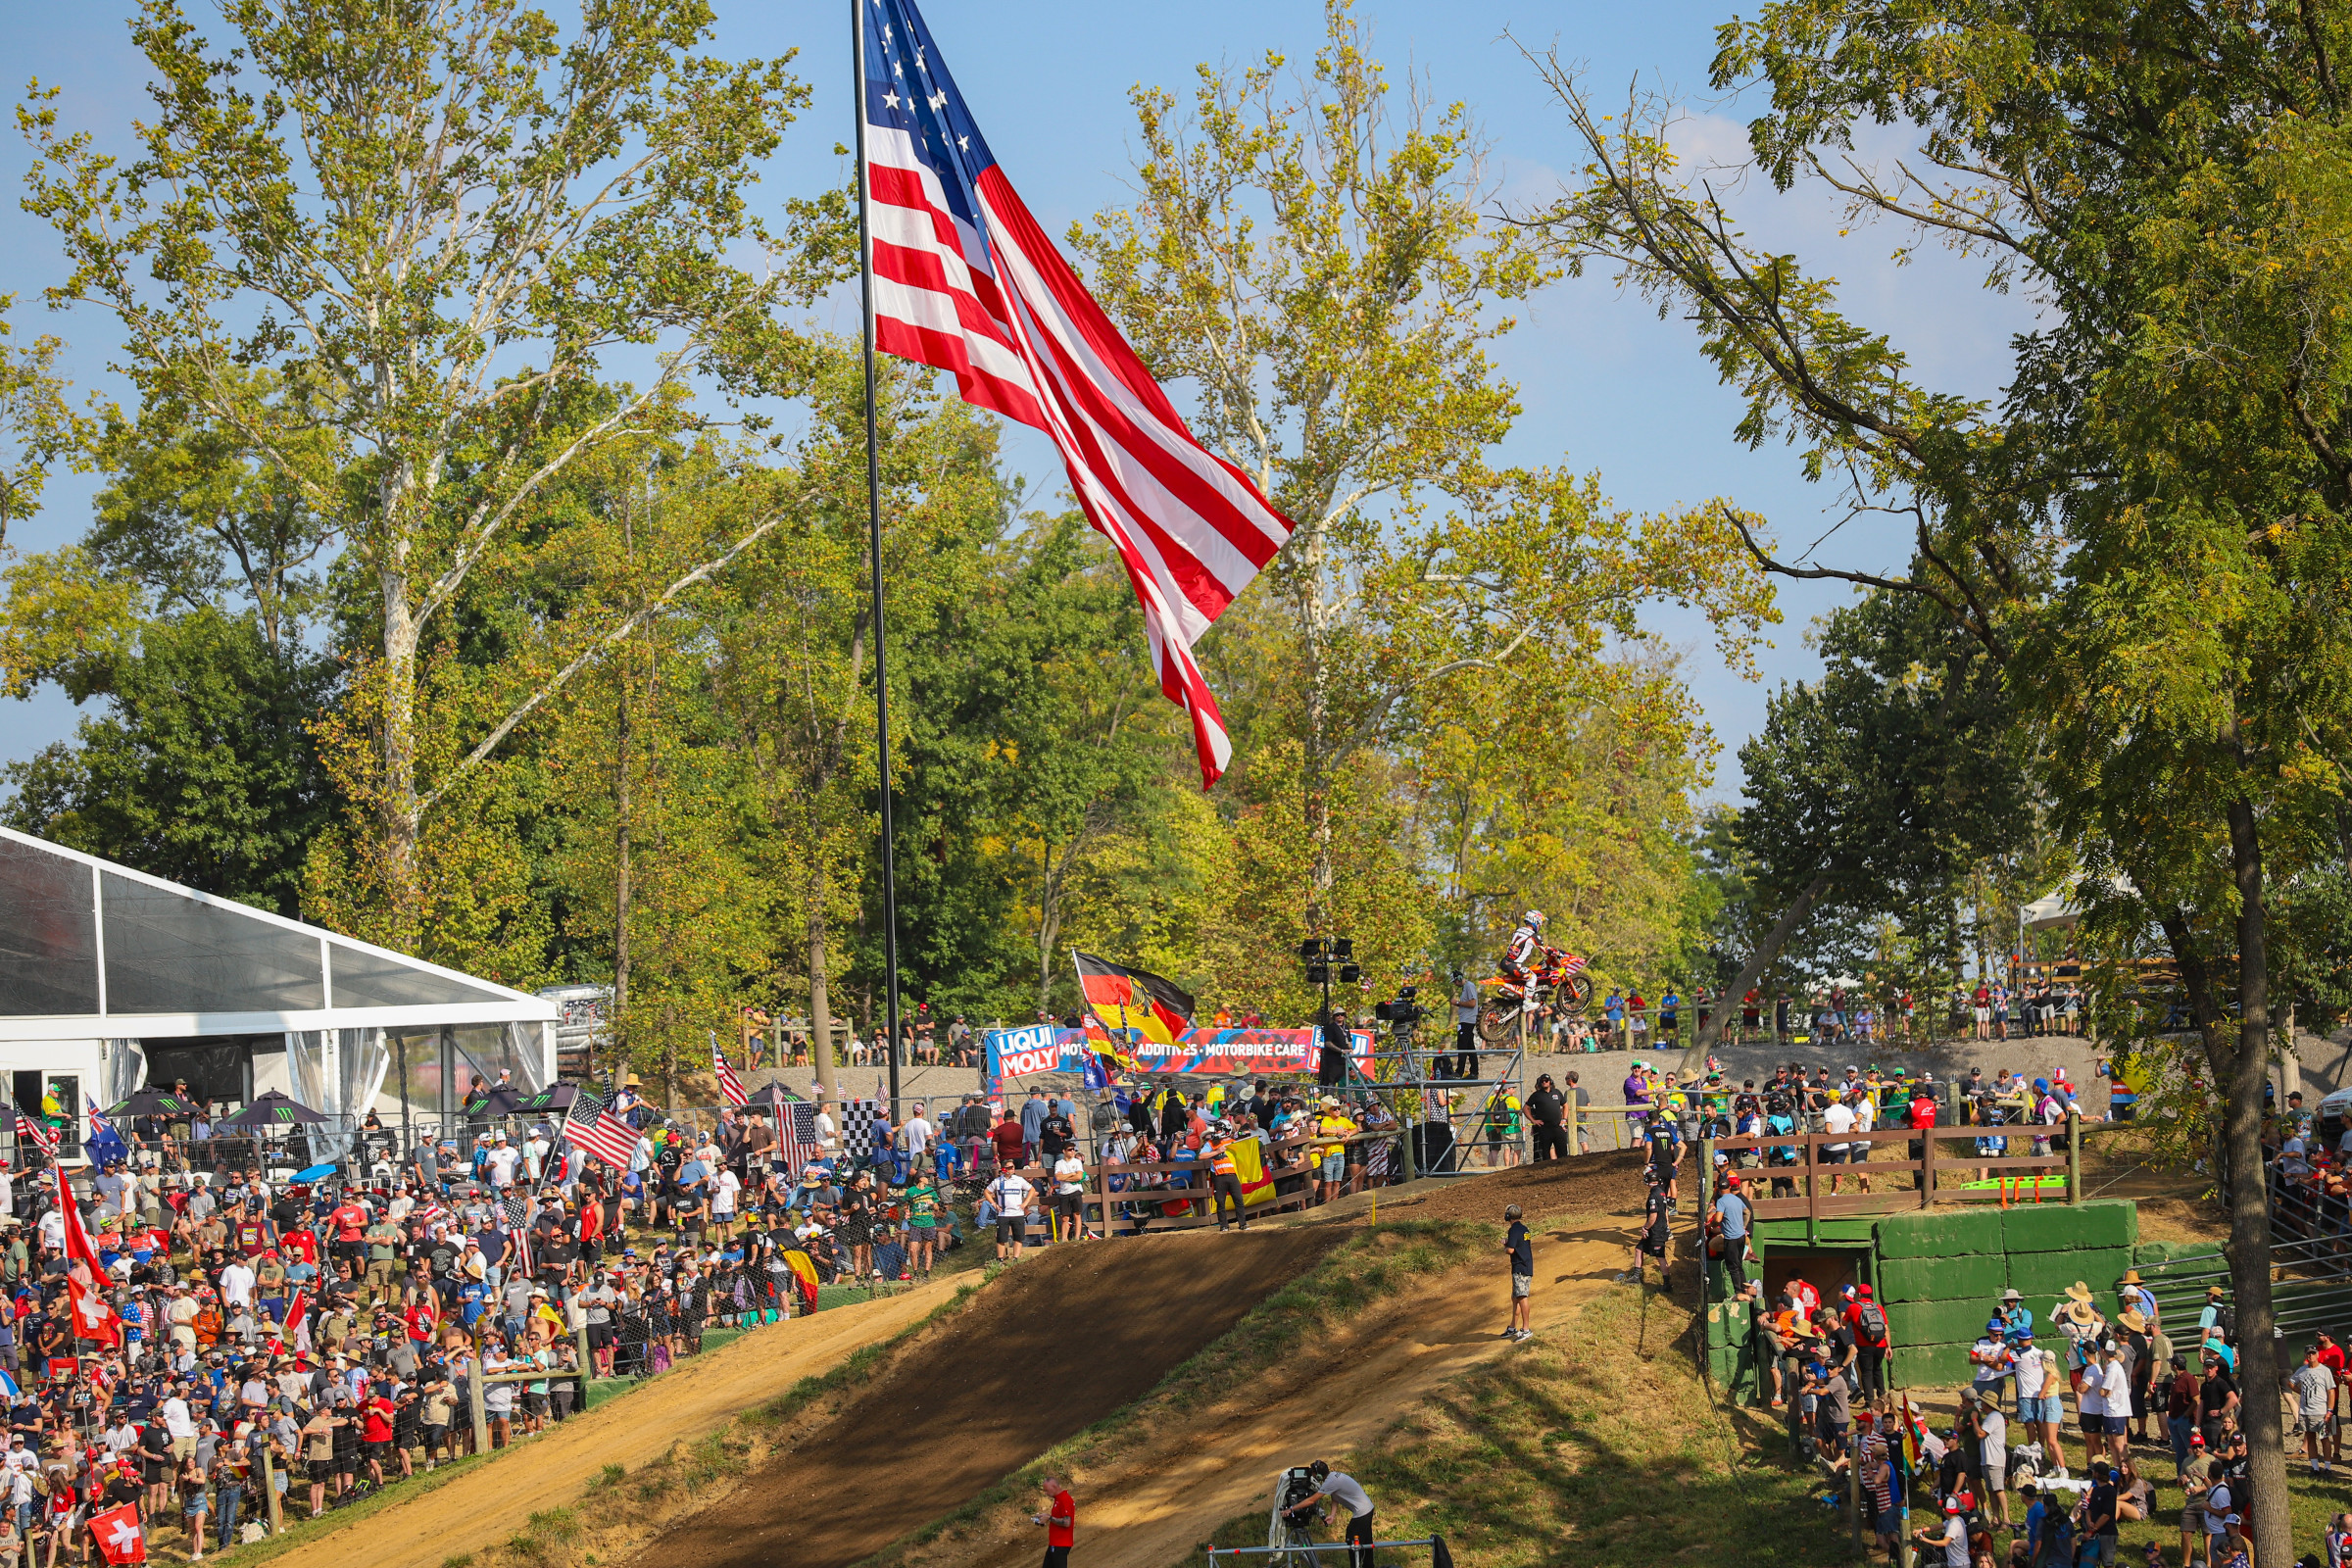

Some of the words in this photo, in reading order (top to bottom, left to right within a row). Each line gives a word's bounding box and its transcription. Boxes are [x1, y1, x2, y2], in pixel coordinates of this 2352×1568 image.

[998, 1026, 1053, 1055] LIQUI
[1205, 1044, 1274, 1055] MOTORBIKE
[1275, 1044, 1305, 1055] CARE
[1002, 1048, 1055, 1078] MOLY
